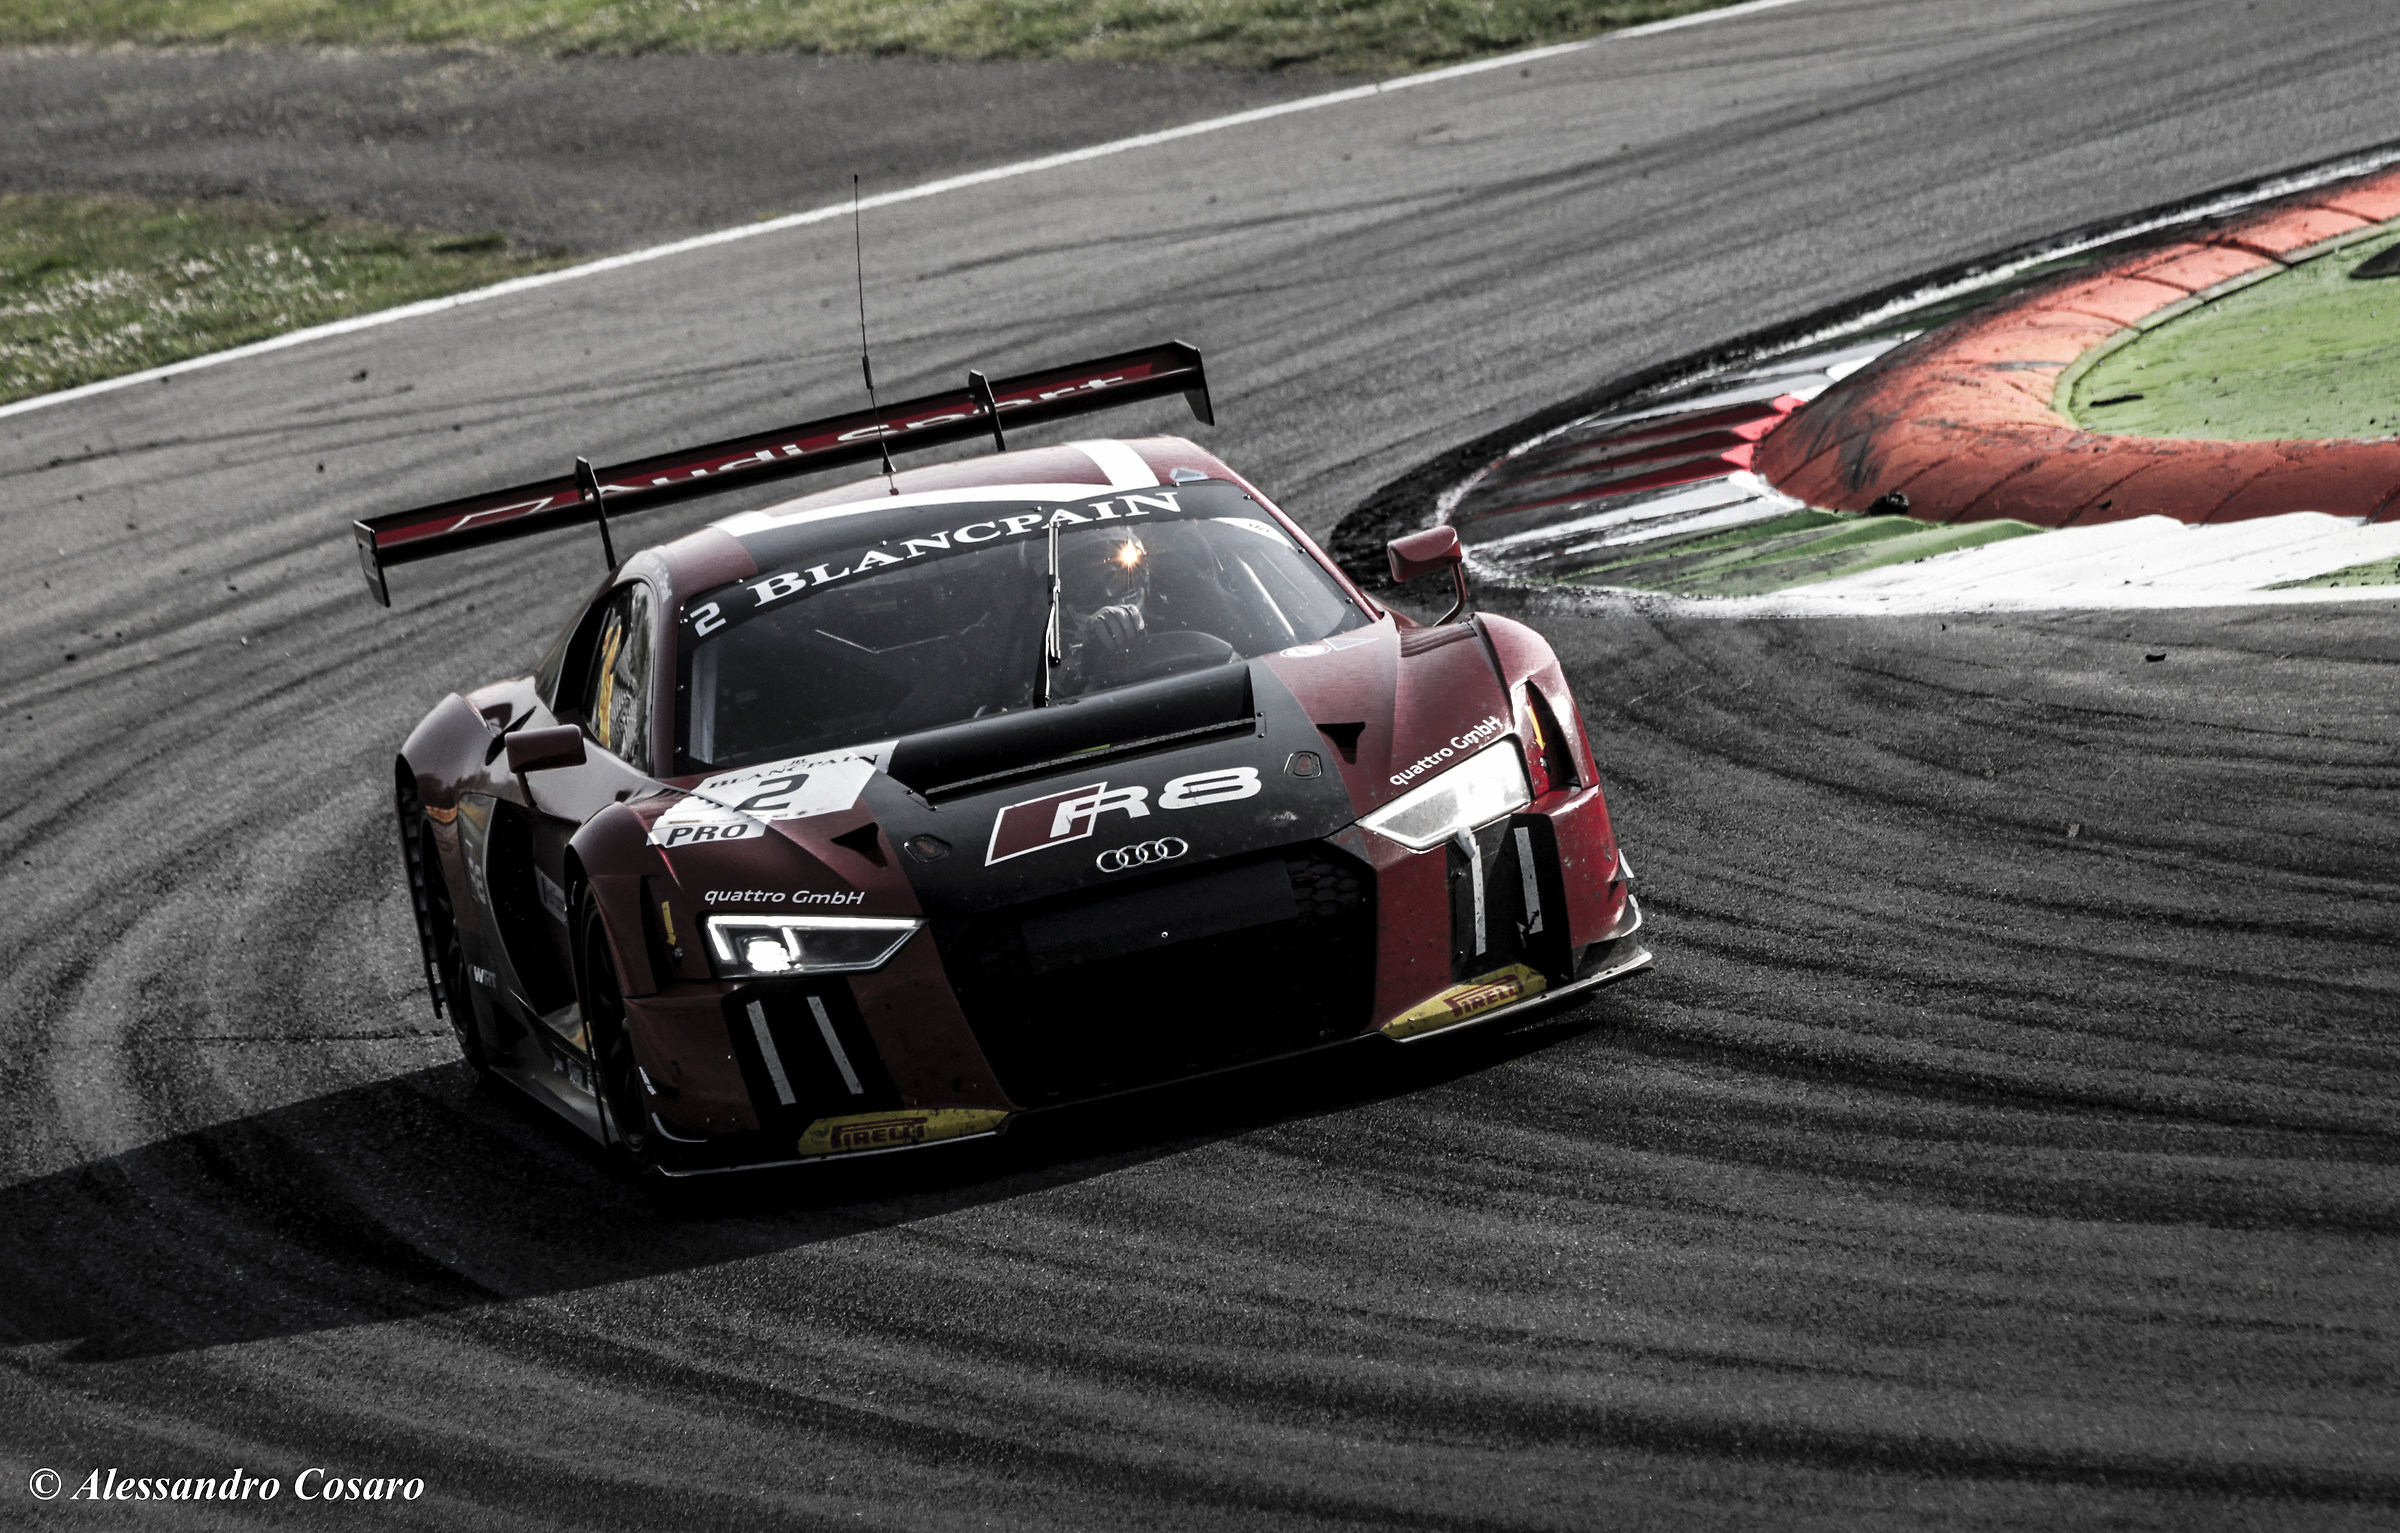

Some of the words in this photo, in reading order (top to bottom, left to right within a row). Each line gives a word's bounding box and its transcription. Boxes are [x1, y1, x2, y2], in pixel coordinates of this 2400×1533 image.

[584, 443, 804, 502] Adi
[746, 491, 1182, 608] BLANCPAIN
[689, 601, 727, 638] 2
[1389, 747, 1454, 786] quattro
[1450, 715, 1503, 750] GmbH
[708, 754, 880, 790] BLANCPAIN
[732, 772, 810, 813] 2
[1049, 766, 1262, 838] R8
[666, 823, 749, 847] PRO
[704, 889, 786, 906] quattro
[792, 890, 866, 906] GmbH
[1442, 974, 1525, 1018] PIRELLI
[830, 1115, 929, 1149] PIRELLI
